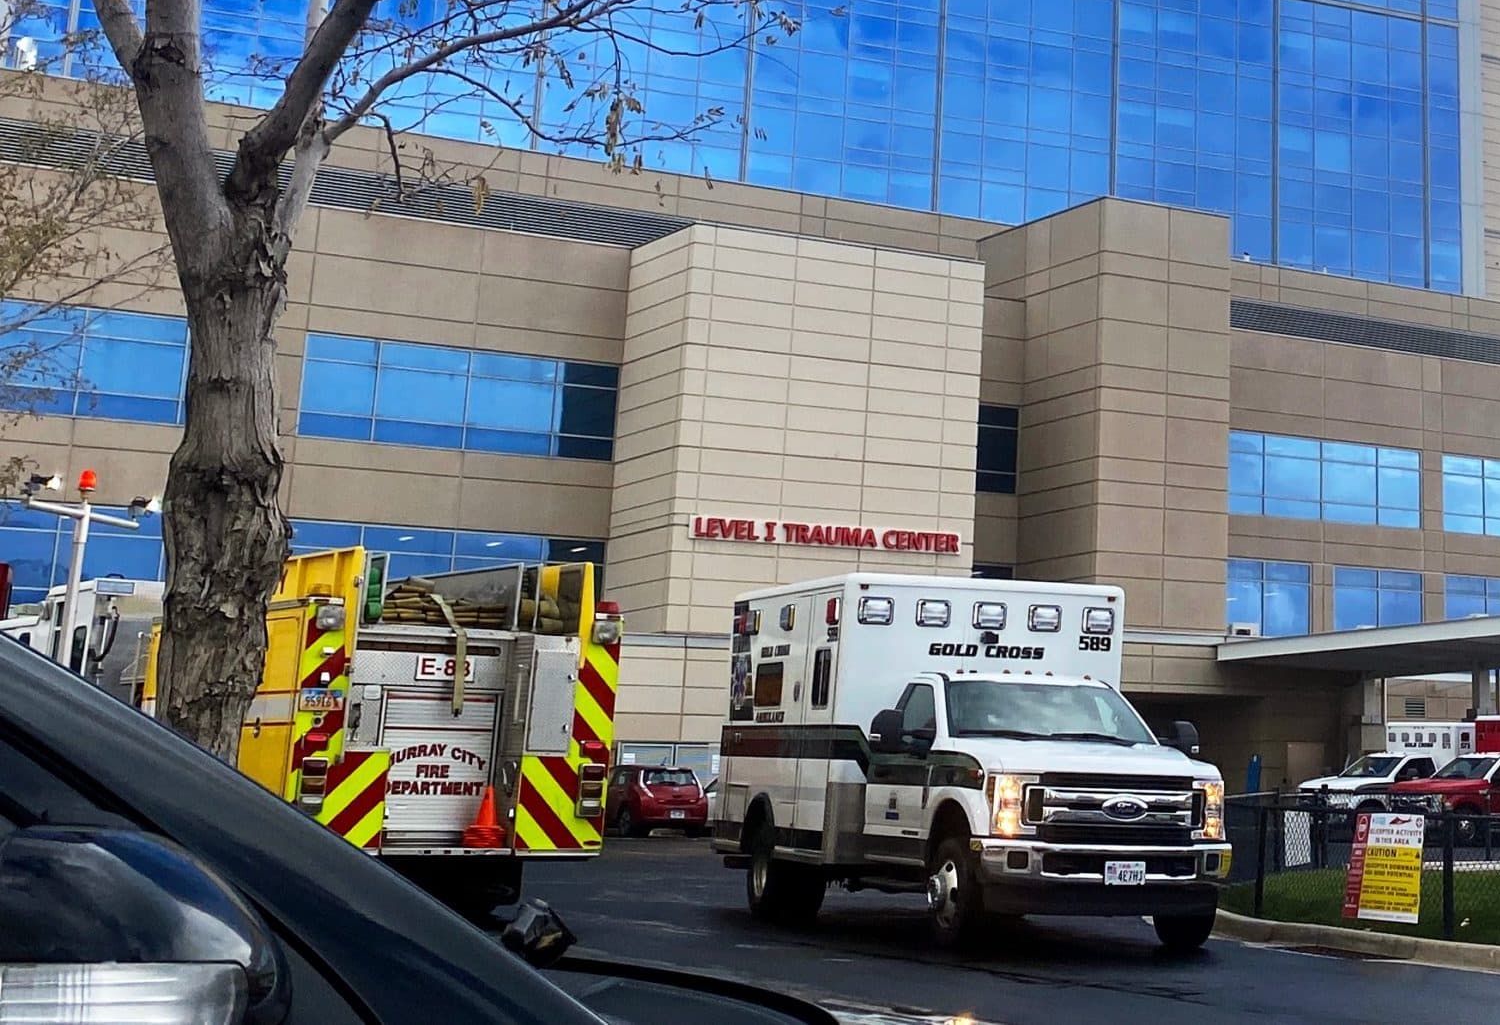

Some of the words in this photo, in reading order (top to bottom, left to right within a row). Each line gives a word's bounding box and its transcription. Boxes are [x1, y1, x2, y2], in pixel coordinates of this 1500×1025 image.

[694, 517, 759, 541] LEVEL
[764, 522, 777, 542] I
[783, 523, 877, 548] TRAUMA
[882, 529, 960, 553] CENTER
[928, 642, 979, 658] GOLD
[984, 645, 1045, 660] CROSS
[1078, 635, 1112, 652] 589
[451, 747, 486, 771] CITY
[415, 764, 450, 778] FIRE
[1367, 848, 1397, 857] CAUTION
